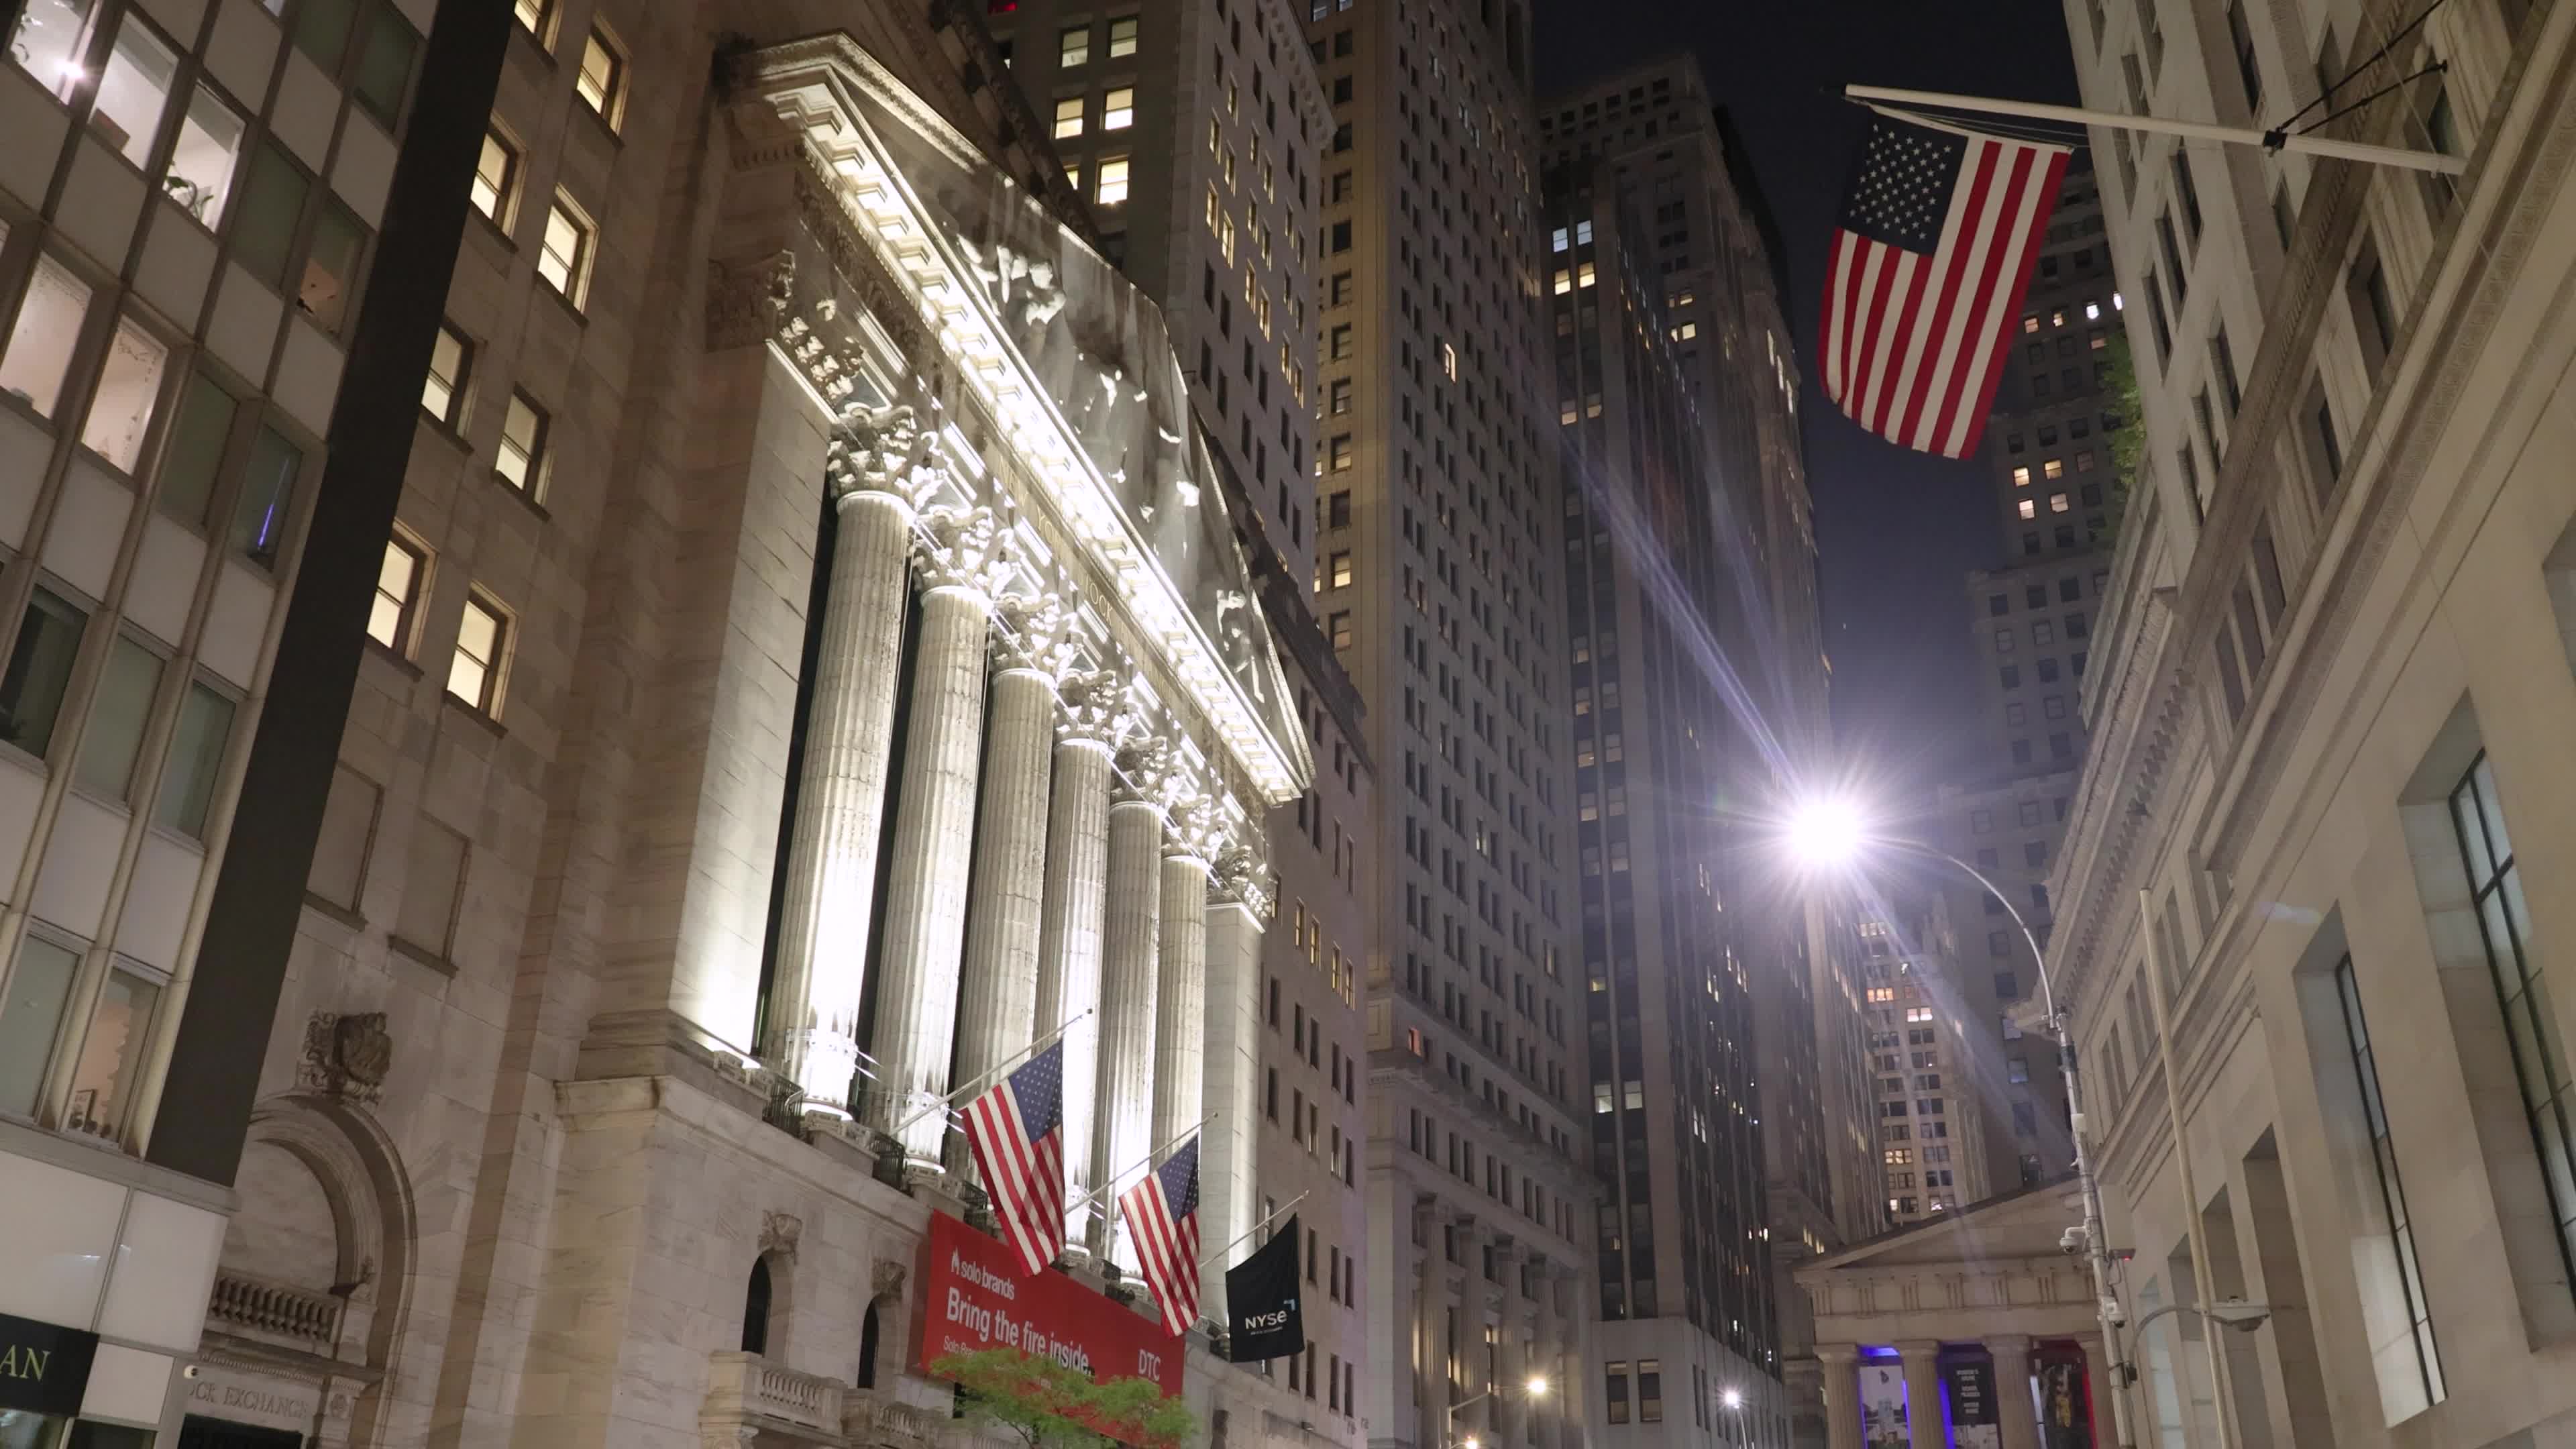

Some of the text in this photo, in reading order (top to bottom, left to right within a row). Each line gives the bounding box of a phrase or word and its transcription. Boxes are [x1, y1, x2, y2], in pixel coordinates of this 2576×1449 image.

[961, 1261, 1015, 1300] solo brands
[944, 1336, 959, 1354] Solo
[947, 1287, 1091, 1376] Bring the fire inside.
[1138, 1348, 1161, 1381] DTC
